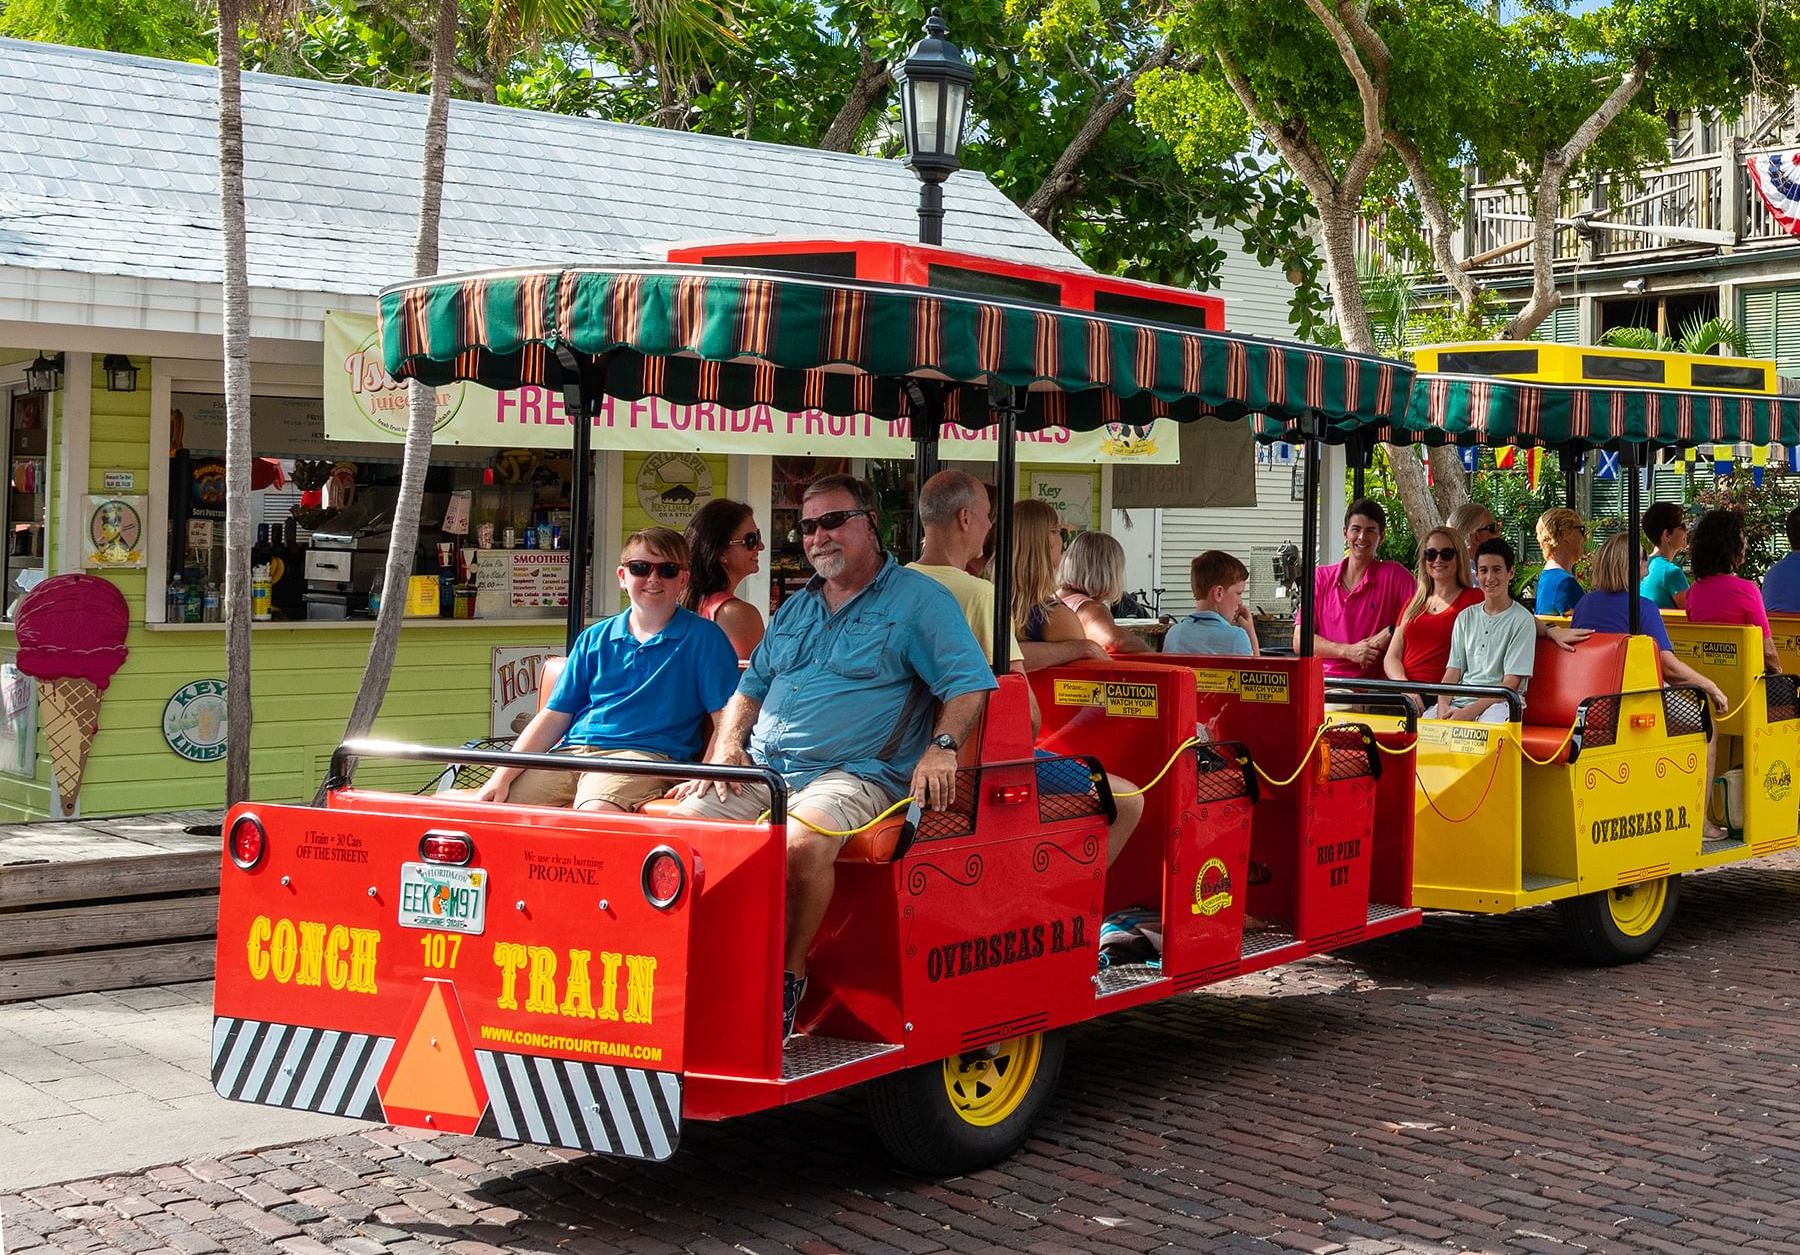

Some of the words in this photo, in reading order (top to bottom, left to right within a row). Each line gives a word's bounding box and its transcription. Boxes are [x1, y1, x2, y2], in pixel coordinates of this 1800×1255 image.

[497, 385, 614, 427] FREH
[630, 396, 774, 434] FLORIDA
[1038, 483, 1062, 498] Key
[513, 554, 570, 564] SMOOTHIES
[1703, 643, 1737, 653] CAUTION
[498, 654, 542, 706] HOT
[1241, 672, 1286, 685] CAUTION
[176, 681, 227, 707] KEY
[1107, 684, 1156, 698] CAUTION
[1255, 693, 1273, 701] STEP!
[1267, 686, 1284, 694] YOUR
[1122, 707, 1142, 715] STEP!
[1133, 699, 1153, 707] YOUR
[1453, 728, 1488, 740] CAUTION
[1591, 810, 1662, 845] OVERSEAS
[1665, 806, 1691, 831] R.R.
[310, 830, 329, 845] Train
[336, 833, 346, 847] 30
[346, 833, 362, 848] Cars
[296, 844, 312, 859] OFF
[313, 846, 330, 861] THE
[331, 848, 369, 864] STREETS!
[524, 850, 536, 862] We
[537, 855, 551, 863] use
[551, 853, 572, 865] clean
[573, 854, 604, 871] burning
[1316, 843, 1335, 866] BIG
[1336, 839, 1361, 862] PINE
[528, 863, 600, 886] PROPANE.
[1330, 865, 1350, 888] KEY
[403, 882, 432, 914] EEK
[450, 887, 479, 919] M97
[247, 915, 381, 995] CONCH
[420, 933, 462, 969] 107
[927, 923, 1045, 983] OVERSEAS
[1051, 915, 1091, 954] R.R.
[493, 941, 657, 1025] TRAIN
[480, 1025, 663, 1062] WWW.CONCHTOURTRAIN.COM
